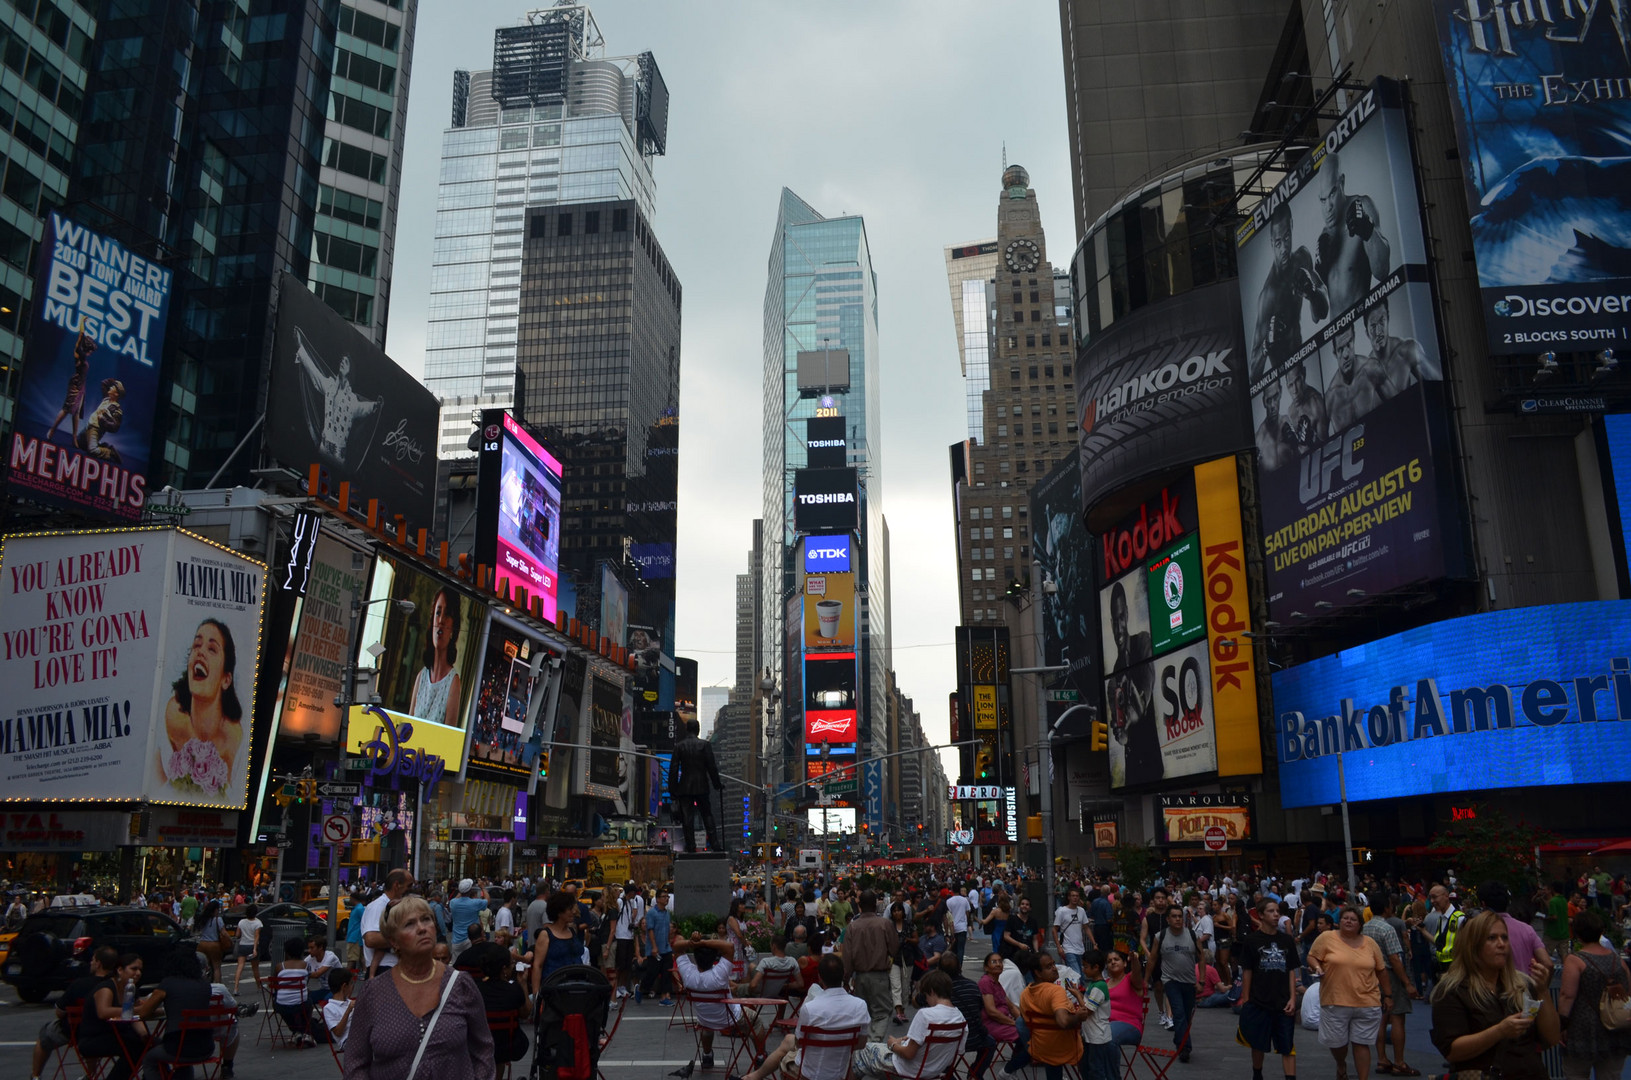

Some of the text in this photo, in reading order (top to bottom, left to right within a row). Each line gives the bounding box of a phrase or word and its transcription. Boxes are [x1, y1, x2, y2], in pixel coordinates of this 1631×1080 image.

[1494, 72, 1631, 106] THE EXHI
[1254, 170, 1299, 230] EVANS
[1313, 147, 1326, 162] TITO
[1326, 88, 1376, 154] ORTIZ
[53, 212, 170, 294] WINNER!
[54, 242, 162, 307] 2010 TONY AWARD
[48, 260, 160, 341] BEST
[1323, 308, 1355, 341] BELFORT
[1364, 274, 1401, 309] AKIYAMA
[44, 297, 154, 366] MUSICAL
[1504, 328, 1616, 344] 2 BLOCKS SOUTH
[1249, 368, 1278, 396] FRANKLIN
[1284, 339, 1317, 370] NOGUEIRA
[816, 408, 838, 417] 2011
[1111, 375, 1233, 425] driving emotion
[484, 442, 499, 451] LG
[808, 439, 846, 448] TOSHIBA
[1352, 438, 1365, 451] 133
[10, 432, 147, 508] MEMPHIS
[1299, 423, 1366, 504] UFC
[150, 505, 187, 513] LAMAR
[799, 492, 855, 505] TOSHIBA
[1264, 457, 1423, 555] SATURDAY, AUGUST 6
[1103, 487, 1185, 580] Kodak
[1274, 546, 1300, 572] LIVE
[1300, 537, 1318, 560] ON
[1318, 490, 1412, 553] PAY-PER-VIEW
[1341, 540, 1358, 559] UFC
[10, 543, 145, 595] YOU ALREADY
[505, 550, 552, 589] Super Slim Super LED
[816, 548, 848, 559] TDK
[175, 561, 257, 605] MAMMA MIA!
[308, 579, 320, 597] IT
[313, 560, 364, 597] YOU'VE MAE
[45, 581, 108, 622] KNOW
[305, 597, 343, 626] BUT WILL
[1203, 540, 1249, 694] Kodak
[3, 609, 151, 661] YOU'RE GONNA
[304, 614, 321, 635] YOU
[321, 619, 332, 641] BE
[300, 632, 342, 662] TO RETIRE
[33, 646, 119, 690] LOVE IT!
[298, 701, 325, 713] Ameritrade
[976, 701, 994, 711] LION
[1055, 691, 1061, 700] W
[1162, 655, 1203, 726] SO
[0, 699, 131, 755] MAMMA MIA!
[976, 713, 995, 723] KING
[1165, 703, 1204, 741] Kodak
[1280, 698, 1368, 763] Bank
[13, 755, 23, 763] THE
[24, 751, 43, 761] SMASH
[43, 750, 52, 759] HIT
[53, 747, 75, 757] MUSICAL
[94, 742, 112, 751] ABBA
[322, 785, 336, 793] ONE
[829, 783, 853, 793] Broadway
[867, 760, 879, 833] TRYX
[960, 787, 998, 798] AERO
[1162, 795, 1250, 805] MARQUIS
[1005, 786, 1018, 842] AÉROPOSTALE
[1177, 815, 1238, 841] FOLLIES
